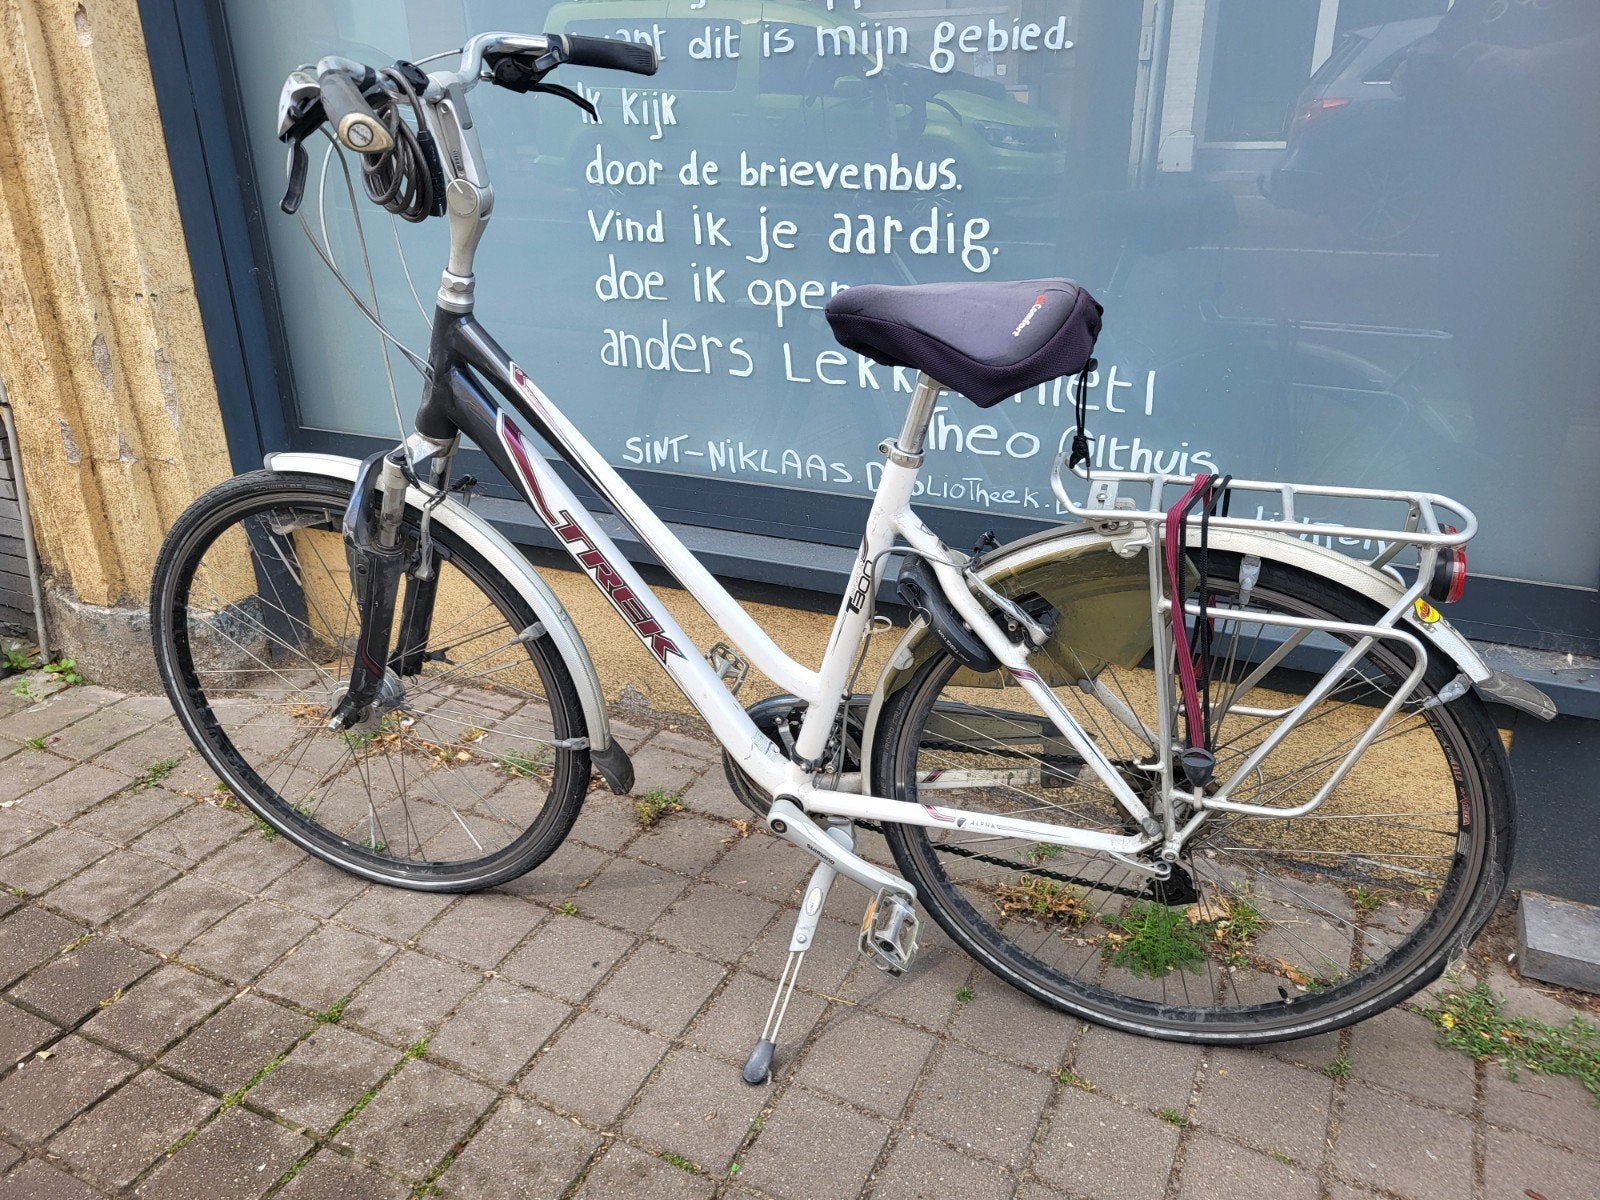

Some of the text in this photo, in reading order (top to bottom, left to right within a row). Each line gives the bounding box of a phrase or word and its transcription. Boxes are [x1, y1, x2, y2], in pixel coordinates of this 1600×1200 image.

[687, 25, 740, 60] dit
[762, 24, 795, 58] is
[815, 22, 909, 77] mijn
[928, 15, 1075, 75] gebied.
[585, 143, 963, 192] door de brievenbus.
[587, 208, 666, 244] Vind
[692, 204, 733, 248] ik
[745, 205, 799, 264] je
[595, 253, 668, 303] doe
[690, 261, 727, 304] ik
[600, 318, 754, 378] anders
[927, 406, 1041, 459] Theo
[555, 510, 688, 666] TREK
